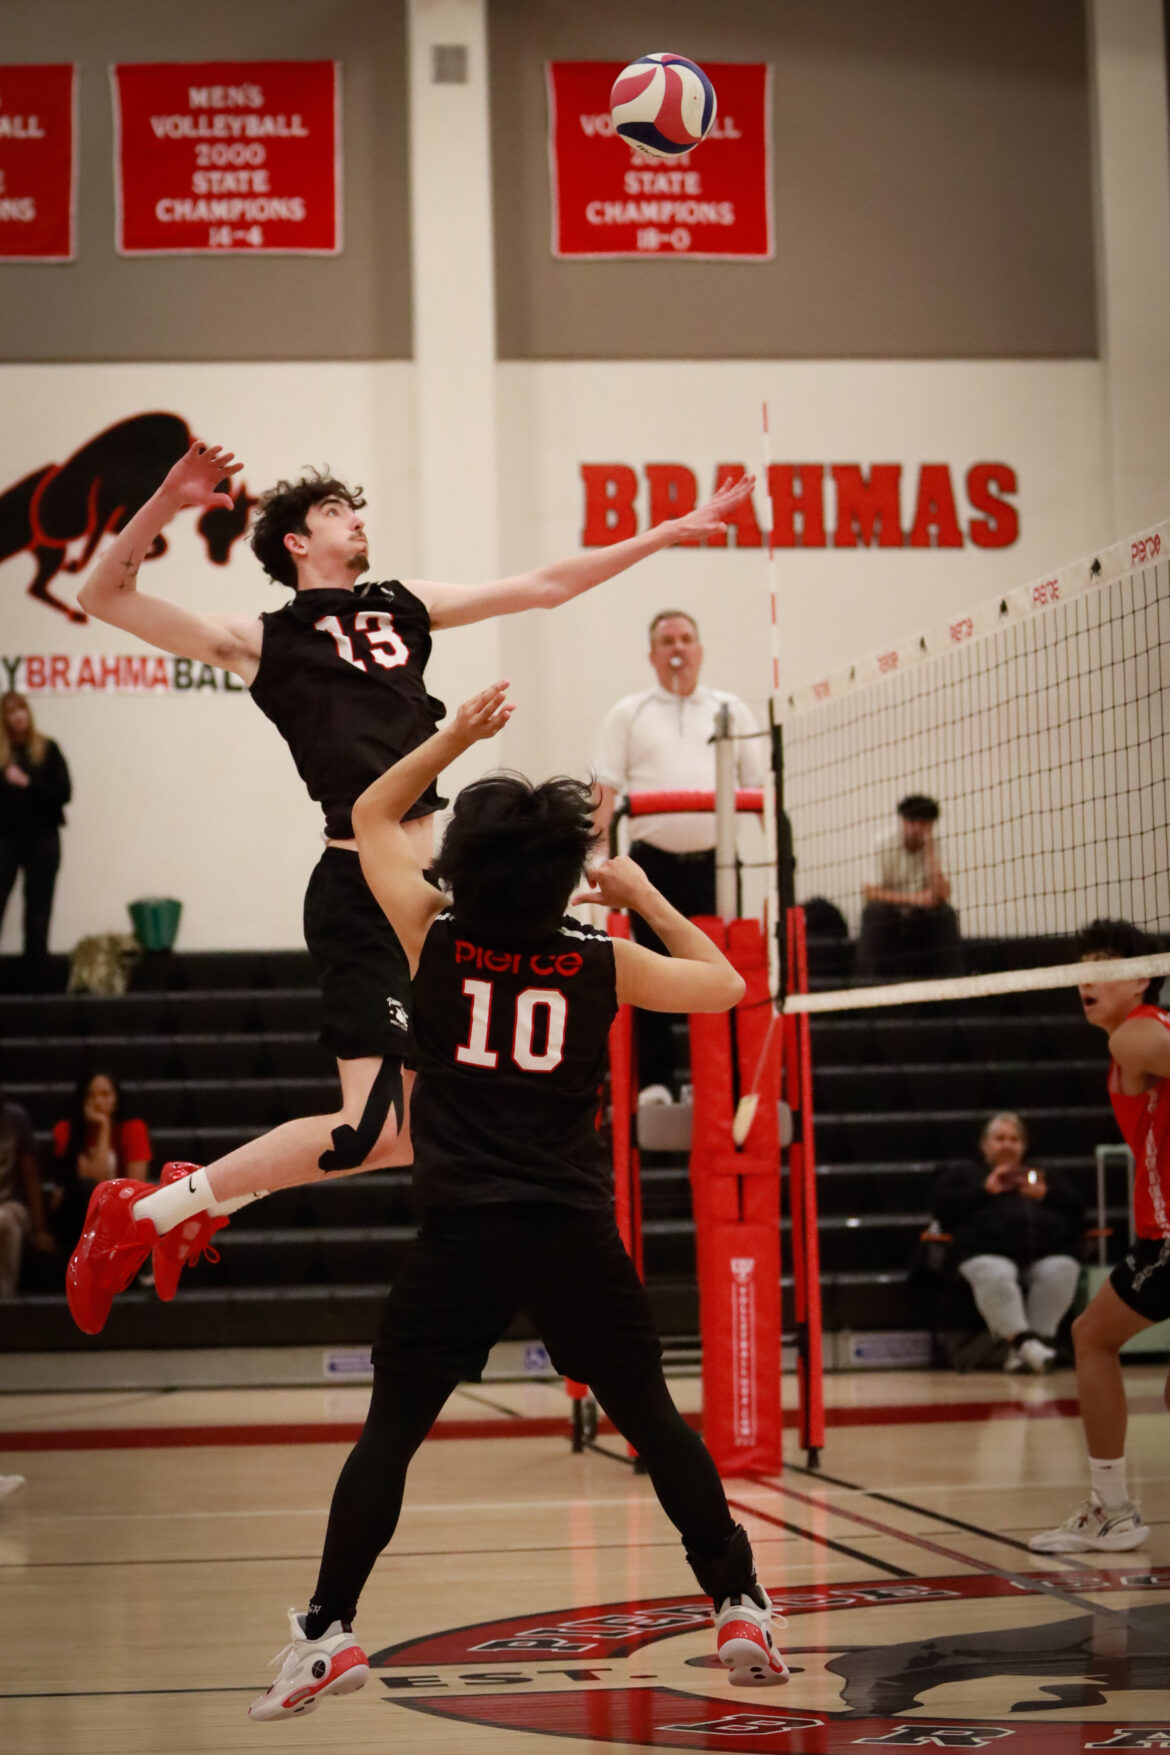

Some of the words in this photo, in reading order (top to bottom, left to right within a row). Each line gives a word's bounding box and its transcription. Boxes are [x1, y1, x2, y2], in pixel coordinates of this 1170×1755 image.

[150, 113, 310, 139] VOLLEYBALL
[194, 142, 267, 167] 2000
[192, 169, 272, 195] STATE
[624, 170, 702, 195] STATE
[155, 196, 307, 223] CHAMPIONS
[585, 201, 736, 226] CHAMPIONS
[579, 461, 1020, 549] BRAHMAS
[313, 610, 410, 673] 13
[455, 976, 568, 1074] 10
